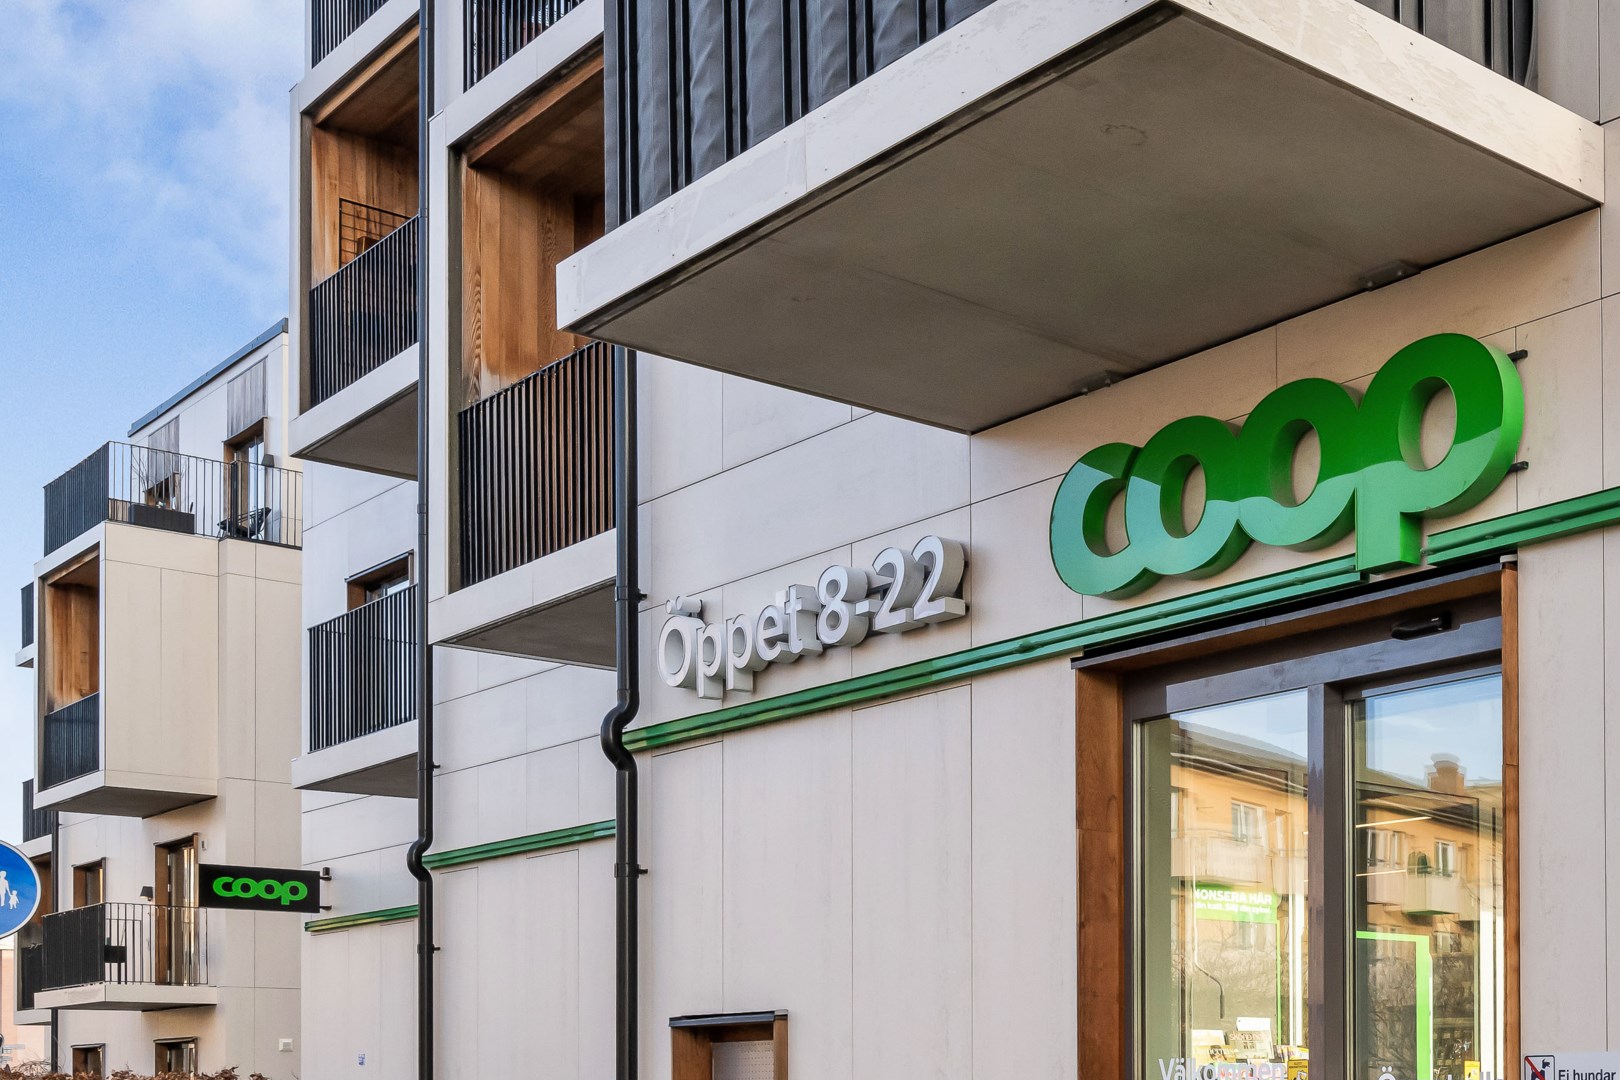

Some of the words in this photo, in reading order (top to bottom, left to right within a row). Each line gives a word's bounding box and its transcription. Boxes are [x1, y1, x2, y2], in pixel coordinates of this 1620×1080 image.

[1050, 332, 1527, 602] coop
[659, 594, 824, 700] Öppet
[817, 535, 968, 648] 8-22
[212, 876, 307, 905] coop
[1195, 889, 1247, 903] NONSERA
